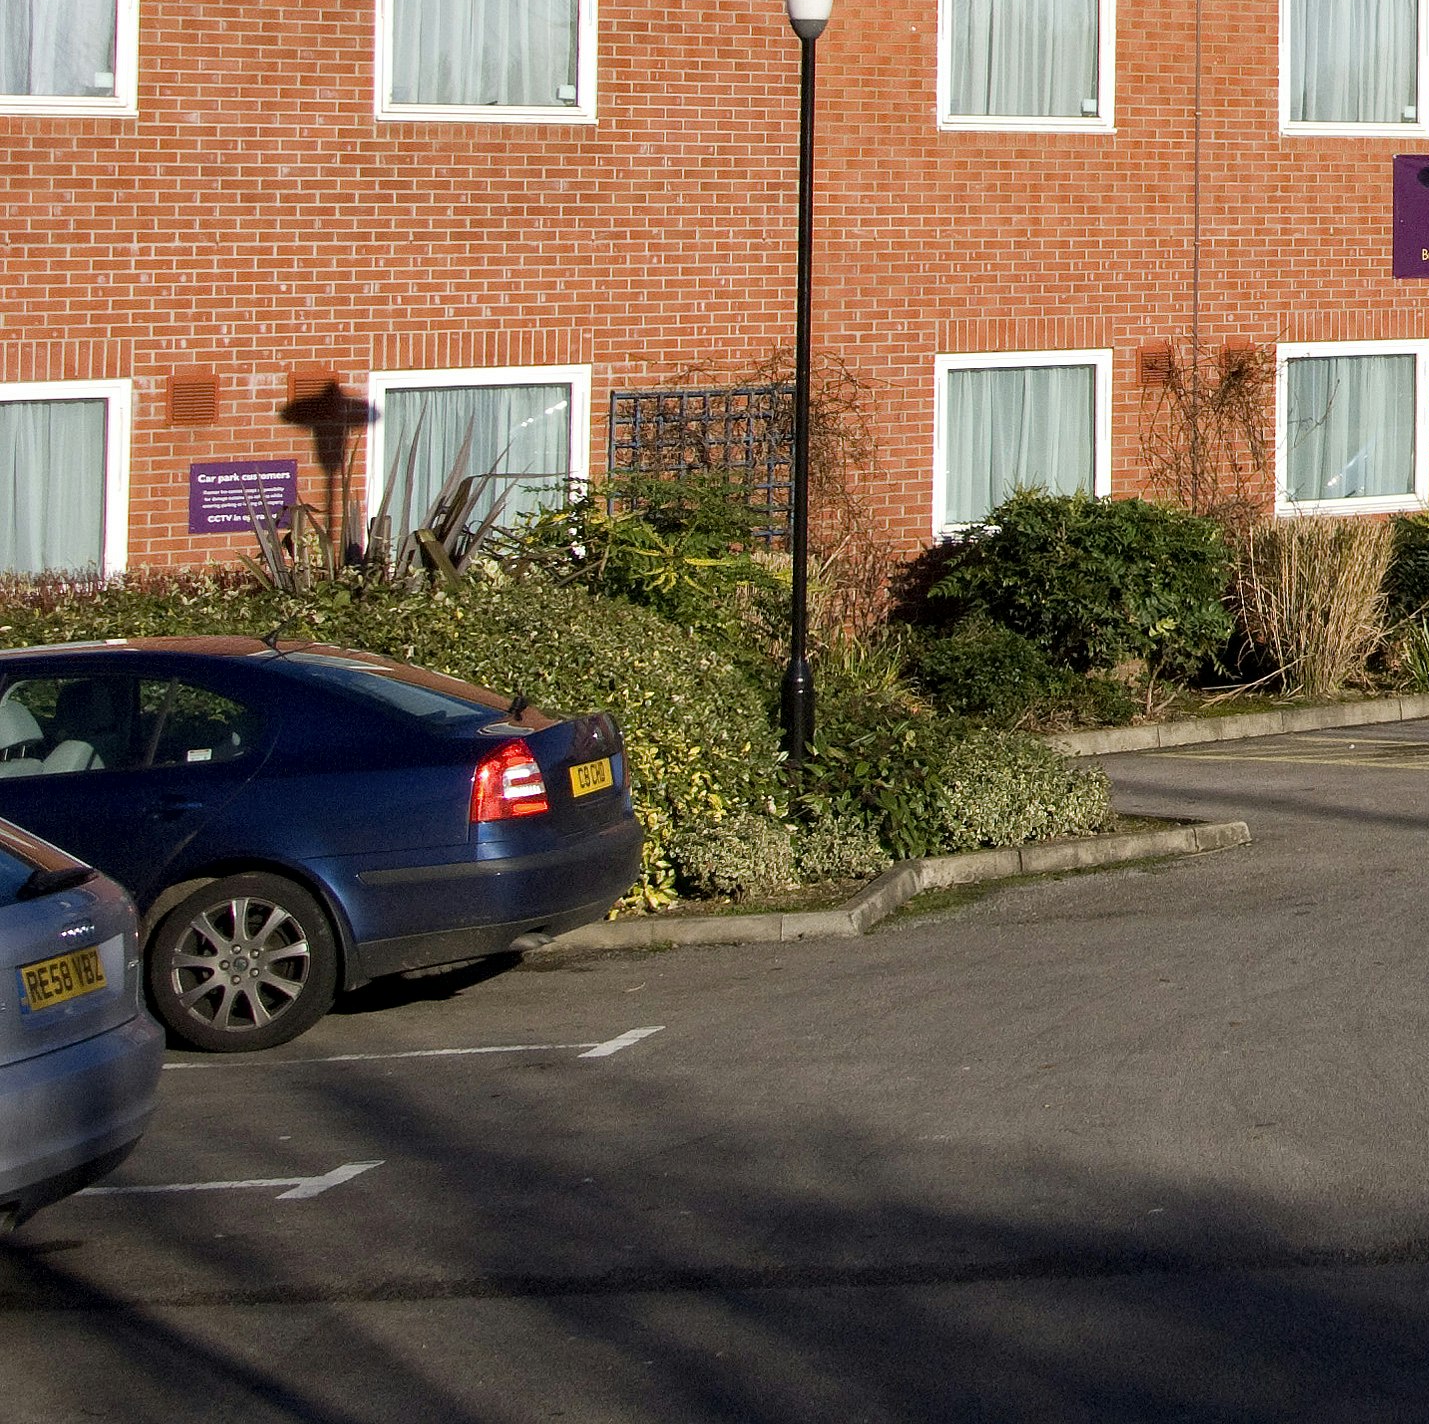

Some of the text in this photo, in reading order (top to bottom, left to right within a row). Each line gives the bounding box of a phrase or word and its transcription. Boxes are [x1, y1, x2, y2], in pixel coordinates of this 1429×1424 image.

[197, 473, 217, 484] Car
[217, 472, 240, 485] park
[207, 513, 233, 523] CCTV
[25, 960, 74, 1004] RE58
